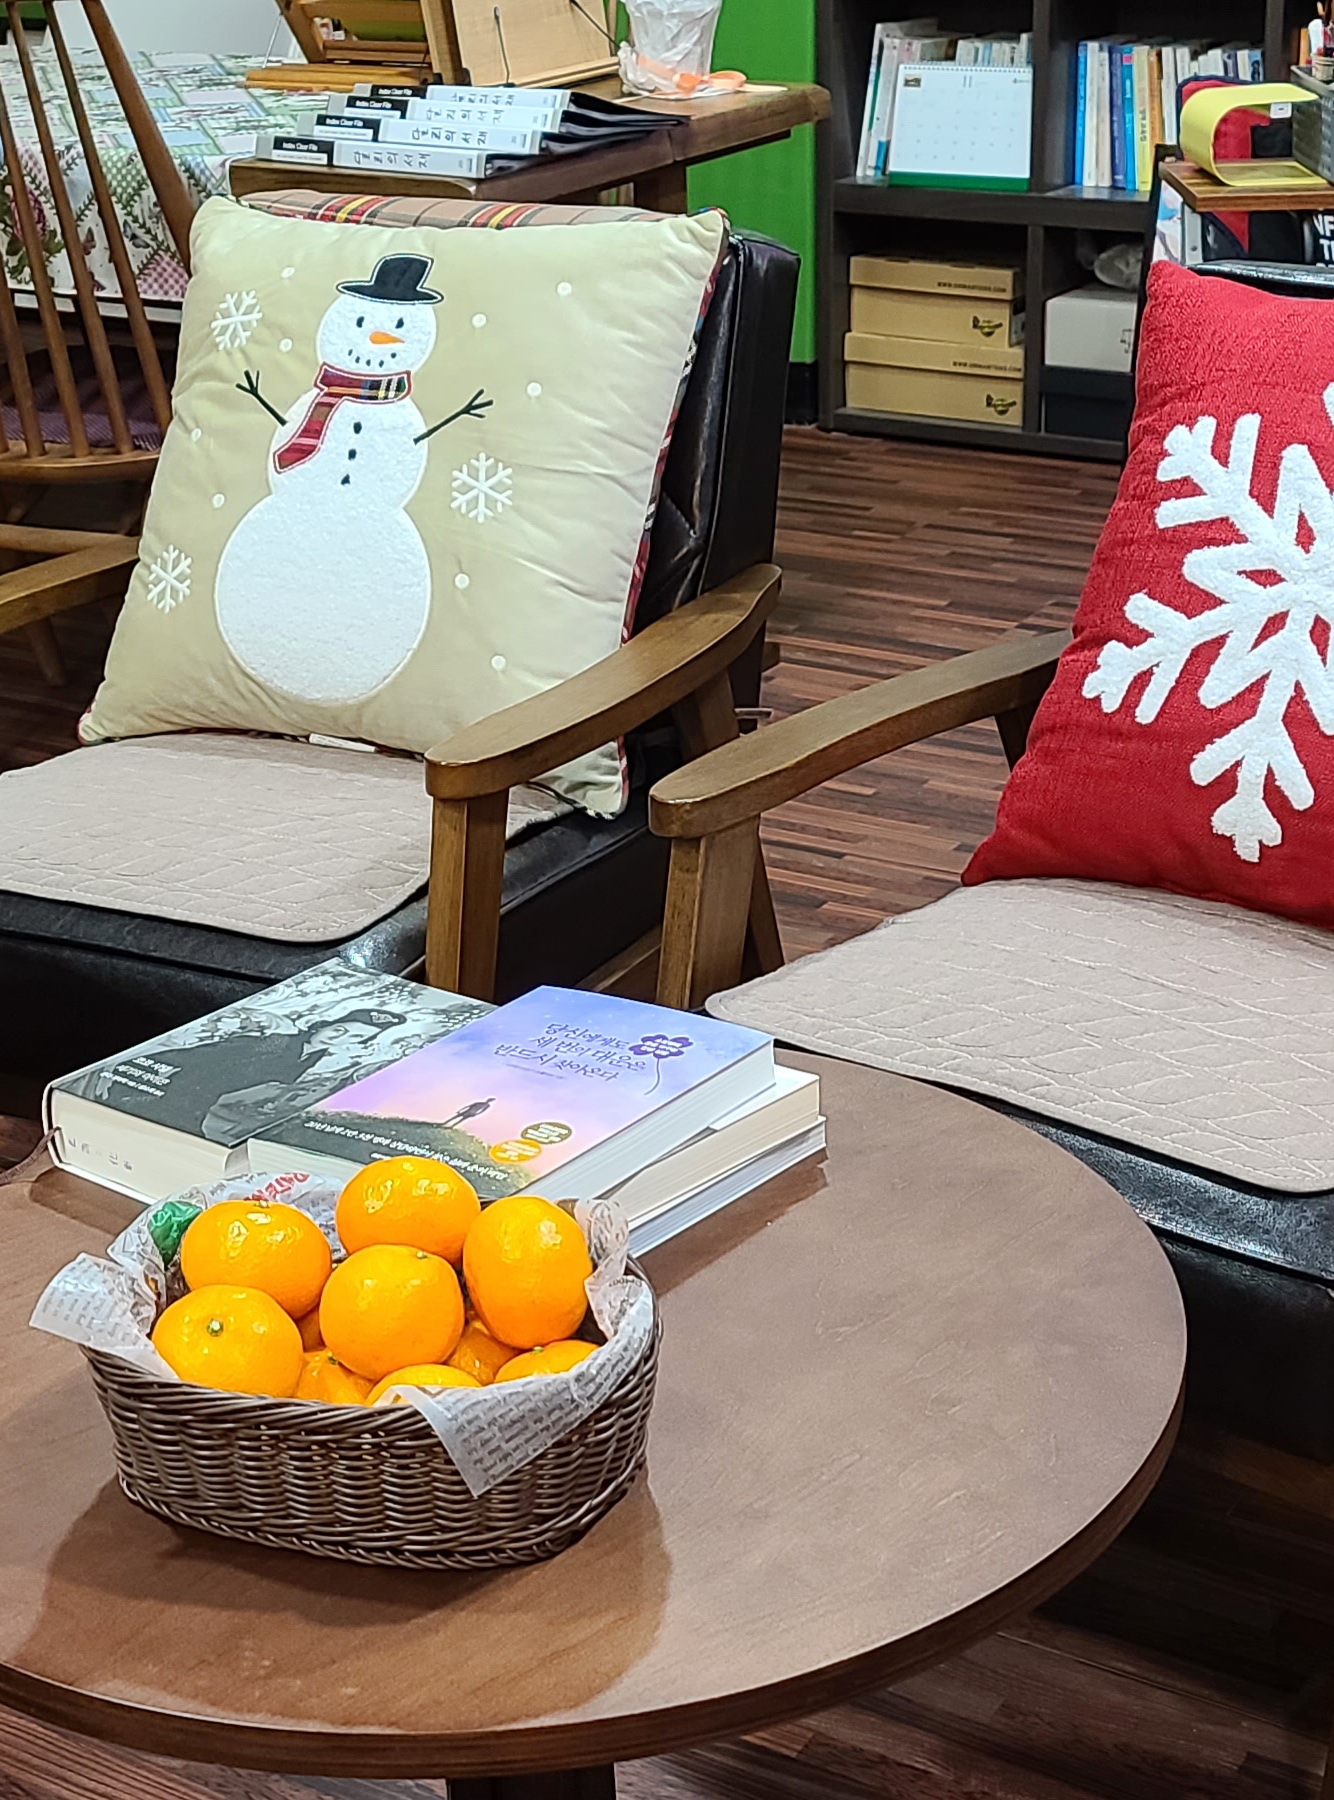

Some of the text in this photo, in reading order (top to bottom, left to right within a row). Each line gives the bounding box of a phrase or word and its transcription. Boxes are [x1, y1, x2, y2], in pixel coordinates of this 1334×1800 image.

[529, 1035, 647, 1072] 세 번의 대운은
[545, 1022, 630, 1050] 당신에게도
[493, 1043, 558, 1066] 반드시
[552, 1059, 620, 1082] 찾아온다
